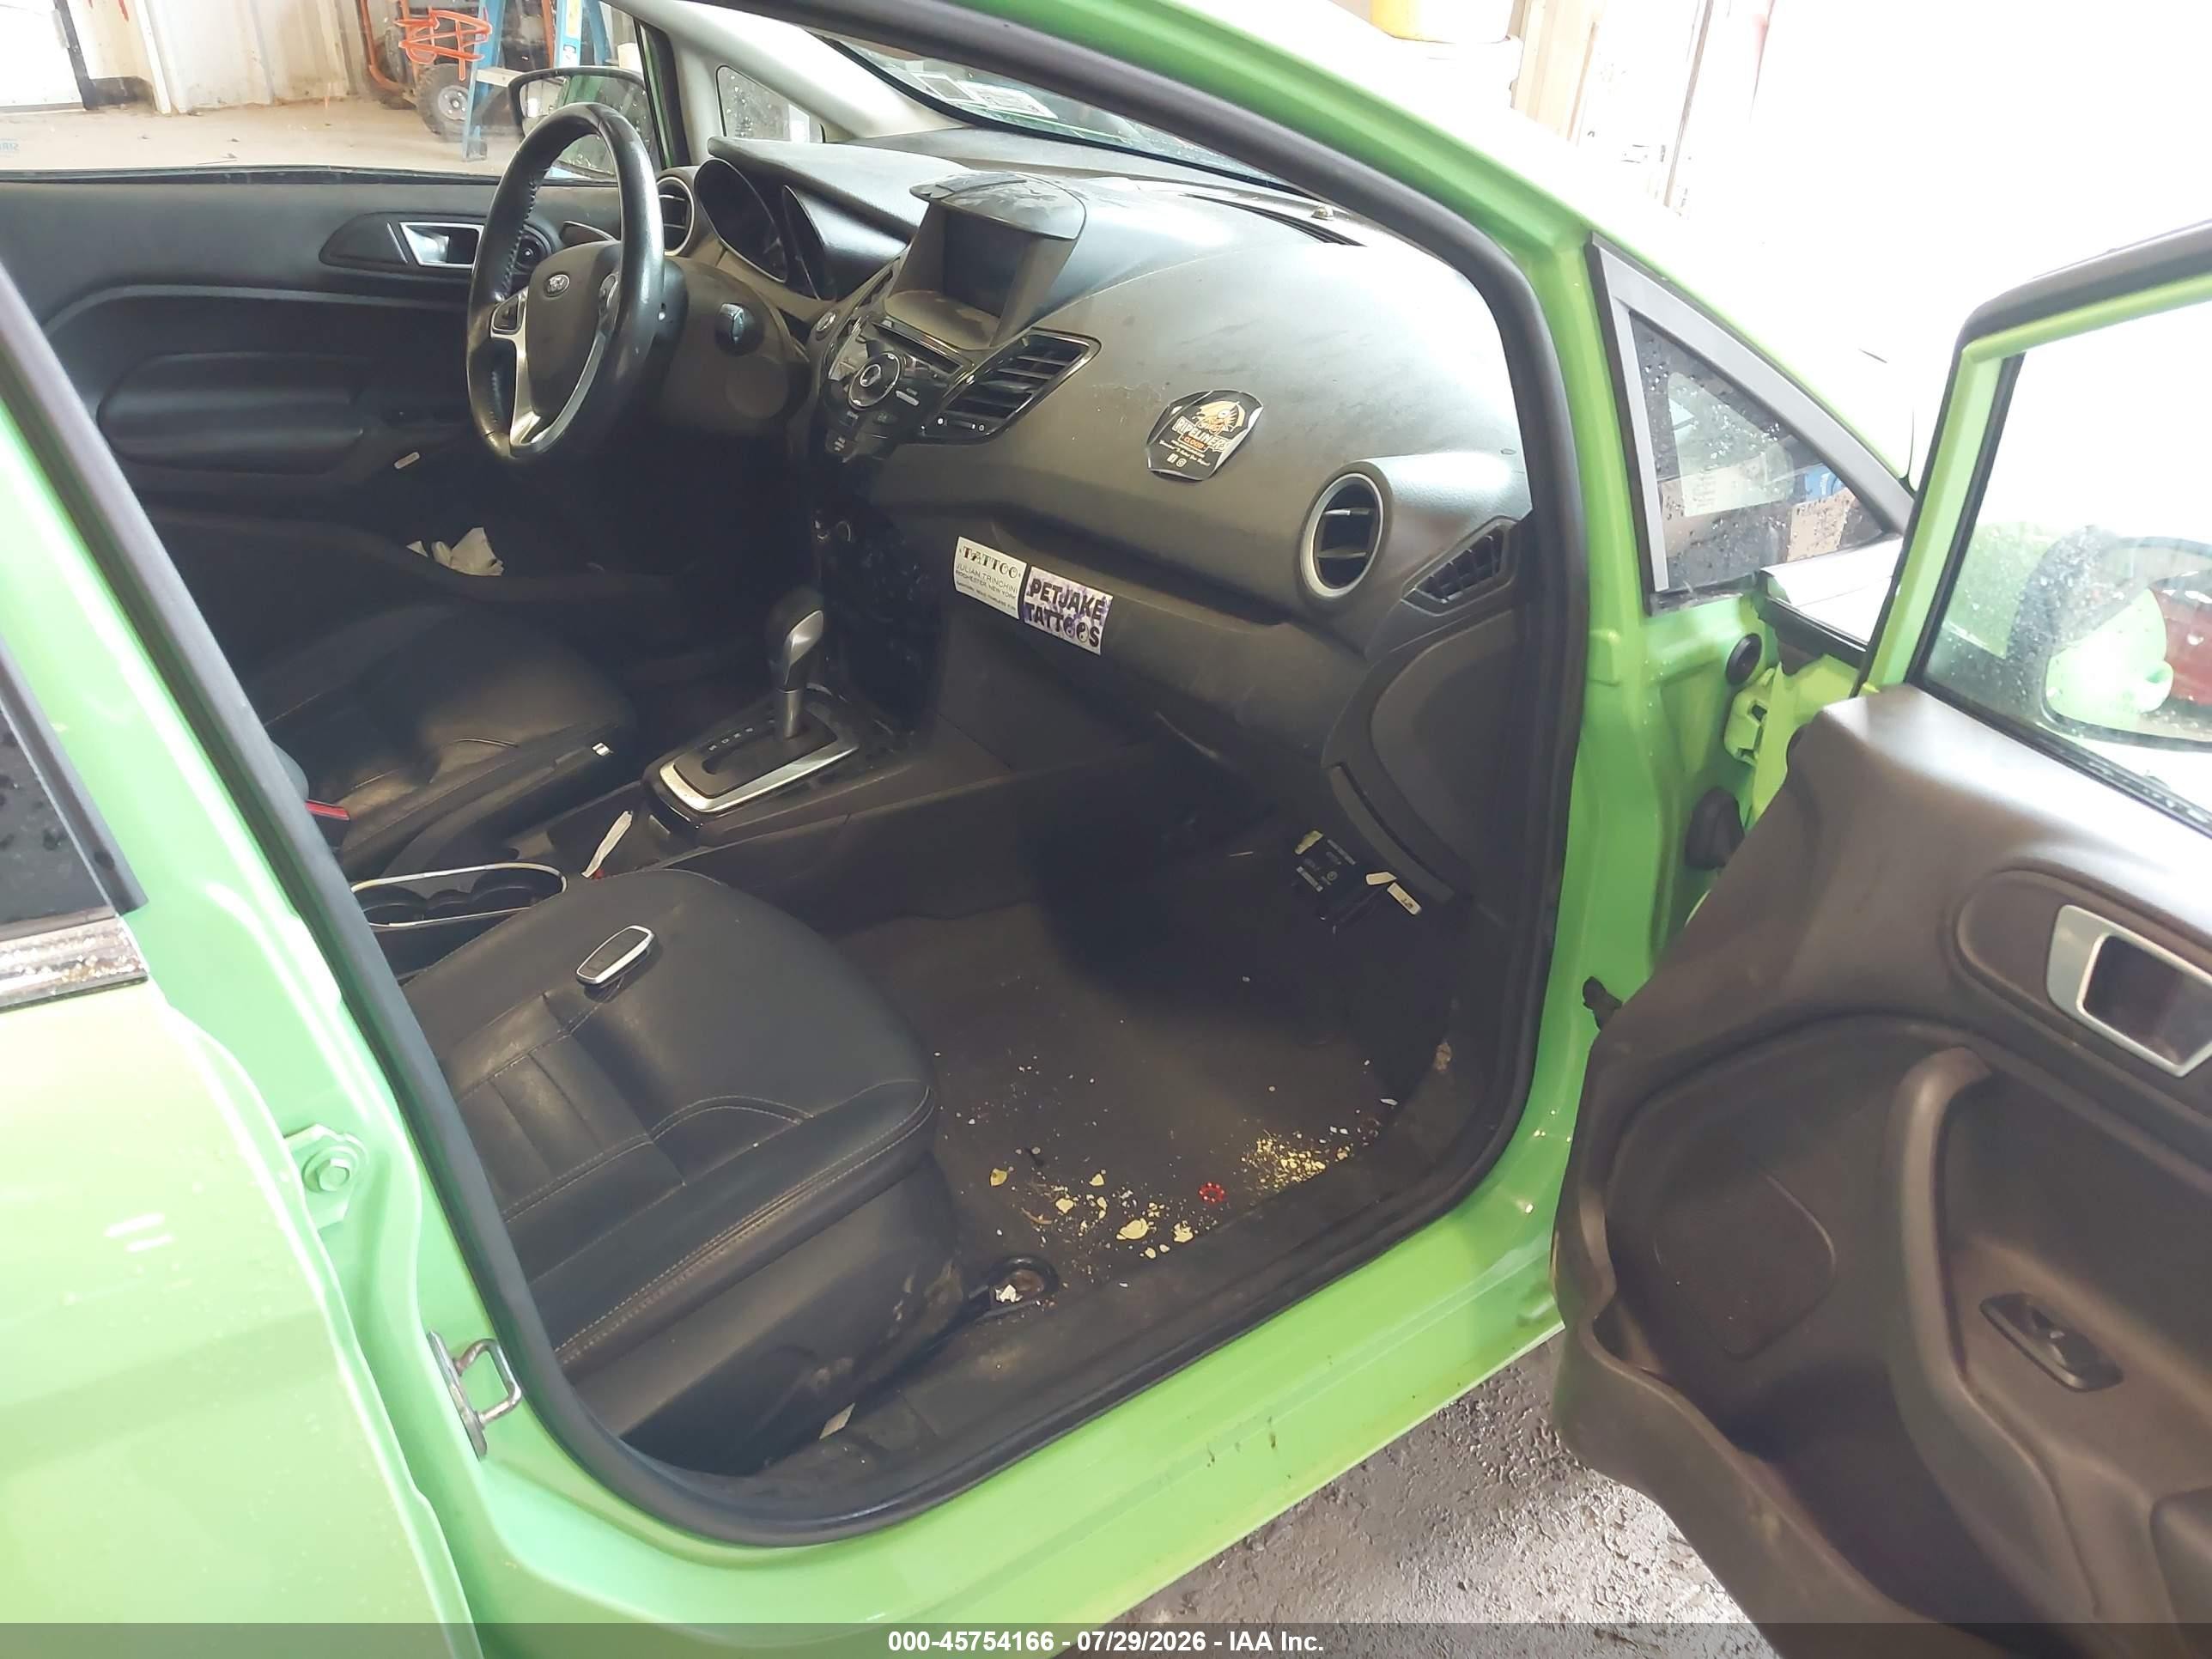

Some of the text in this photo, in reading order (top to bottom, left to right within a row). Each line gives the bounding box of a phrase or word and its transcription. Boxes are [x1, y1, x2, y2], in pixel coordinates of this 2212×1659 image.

[956, 563, 981, 578] JULIAN
[963, 545, 1018, 578] TATTOO
[1029, 578, 1106, 620] PETJAKE
[1025, 602, 1100, 647] TATTOOS
